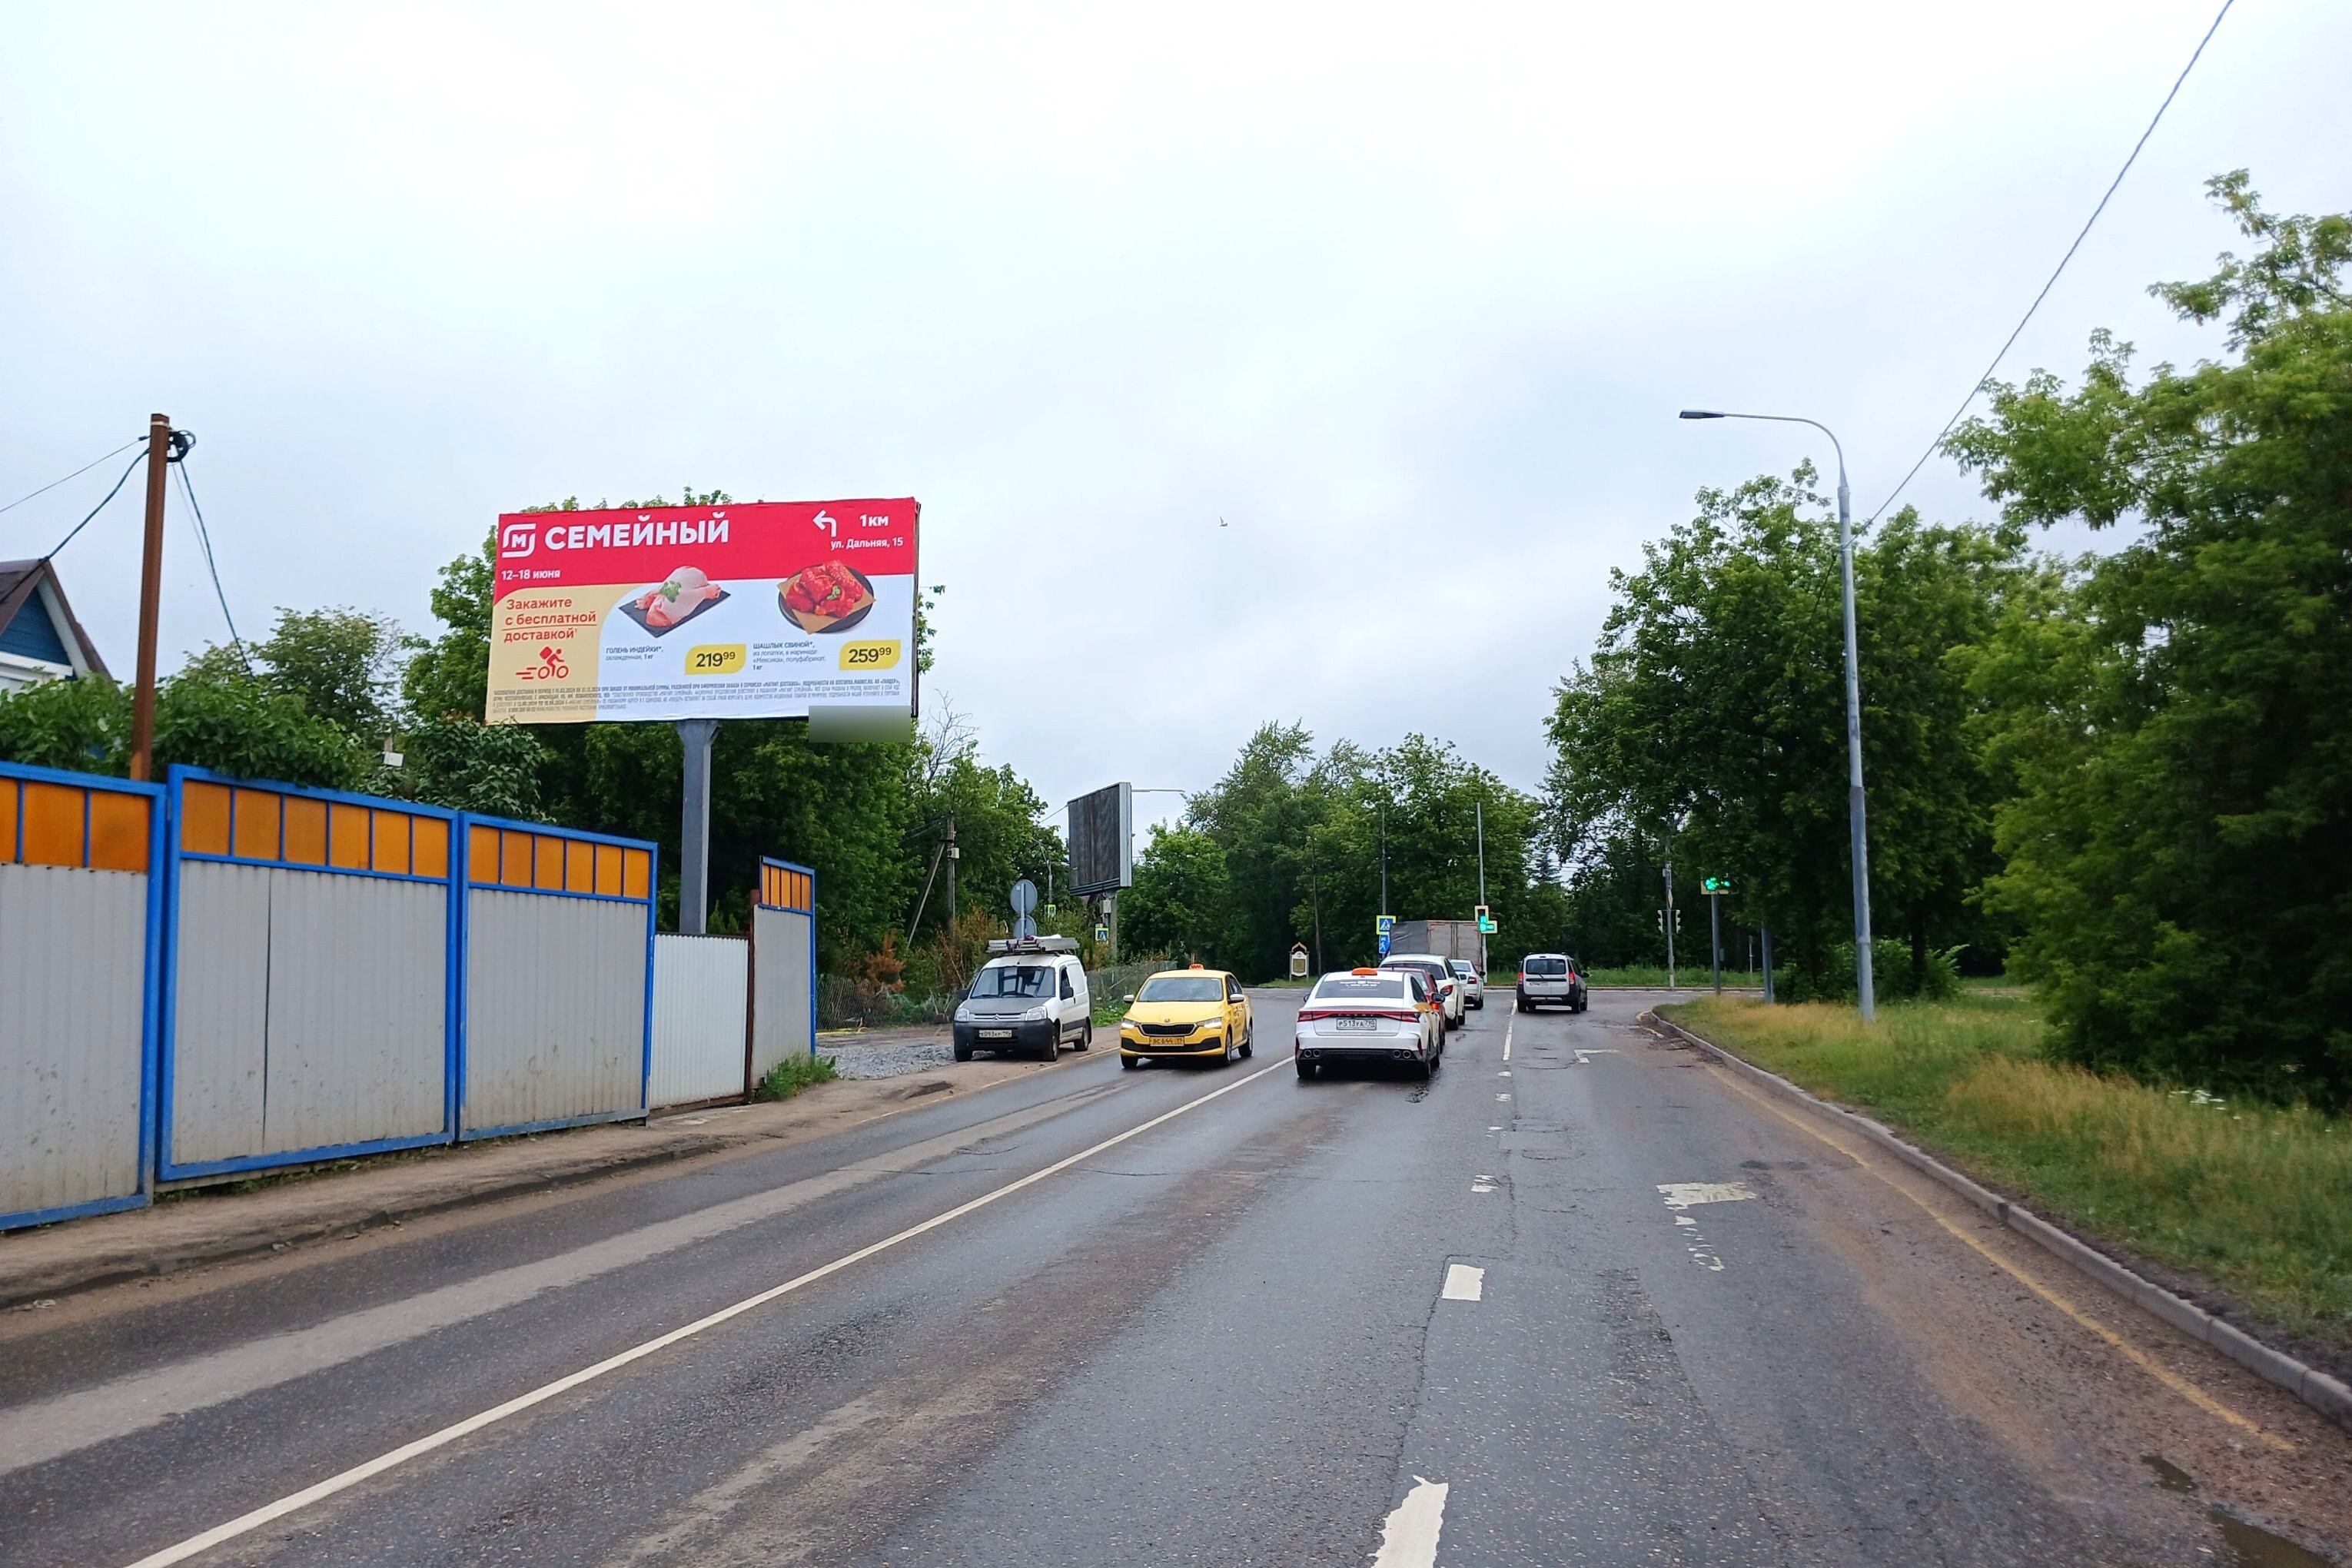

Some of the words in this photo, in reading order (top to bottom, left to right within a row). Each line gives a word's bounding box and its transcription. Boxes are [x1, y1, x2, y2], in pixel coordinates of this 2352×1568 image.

[544, 512, 729, 550] СЕМЕЙНЫЙ
[830, 540, 845, 550] ул.
[846, 538, 890, 550] Дальняя,
[892, 537, 904, 546] 15
[533, 570, 561, 580] июня
[506, 598, 573, 610] Закажите
[505, 616, 513, 626] с
[517, 611, 596, 626] бесплатной
